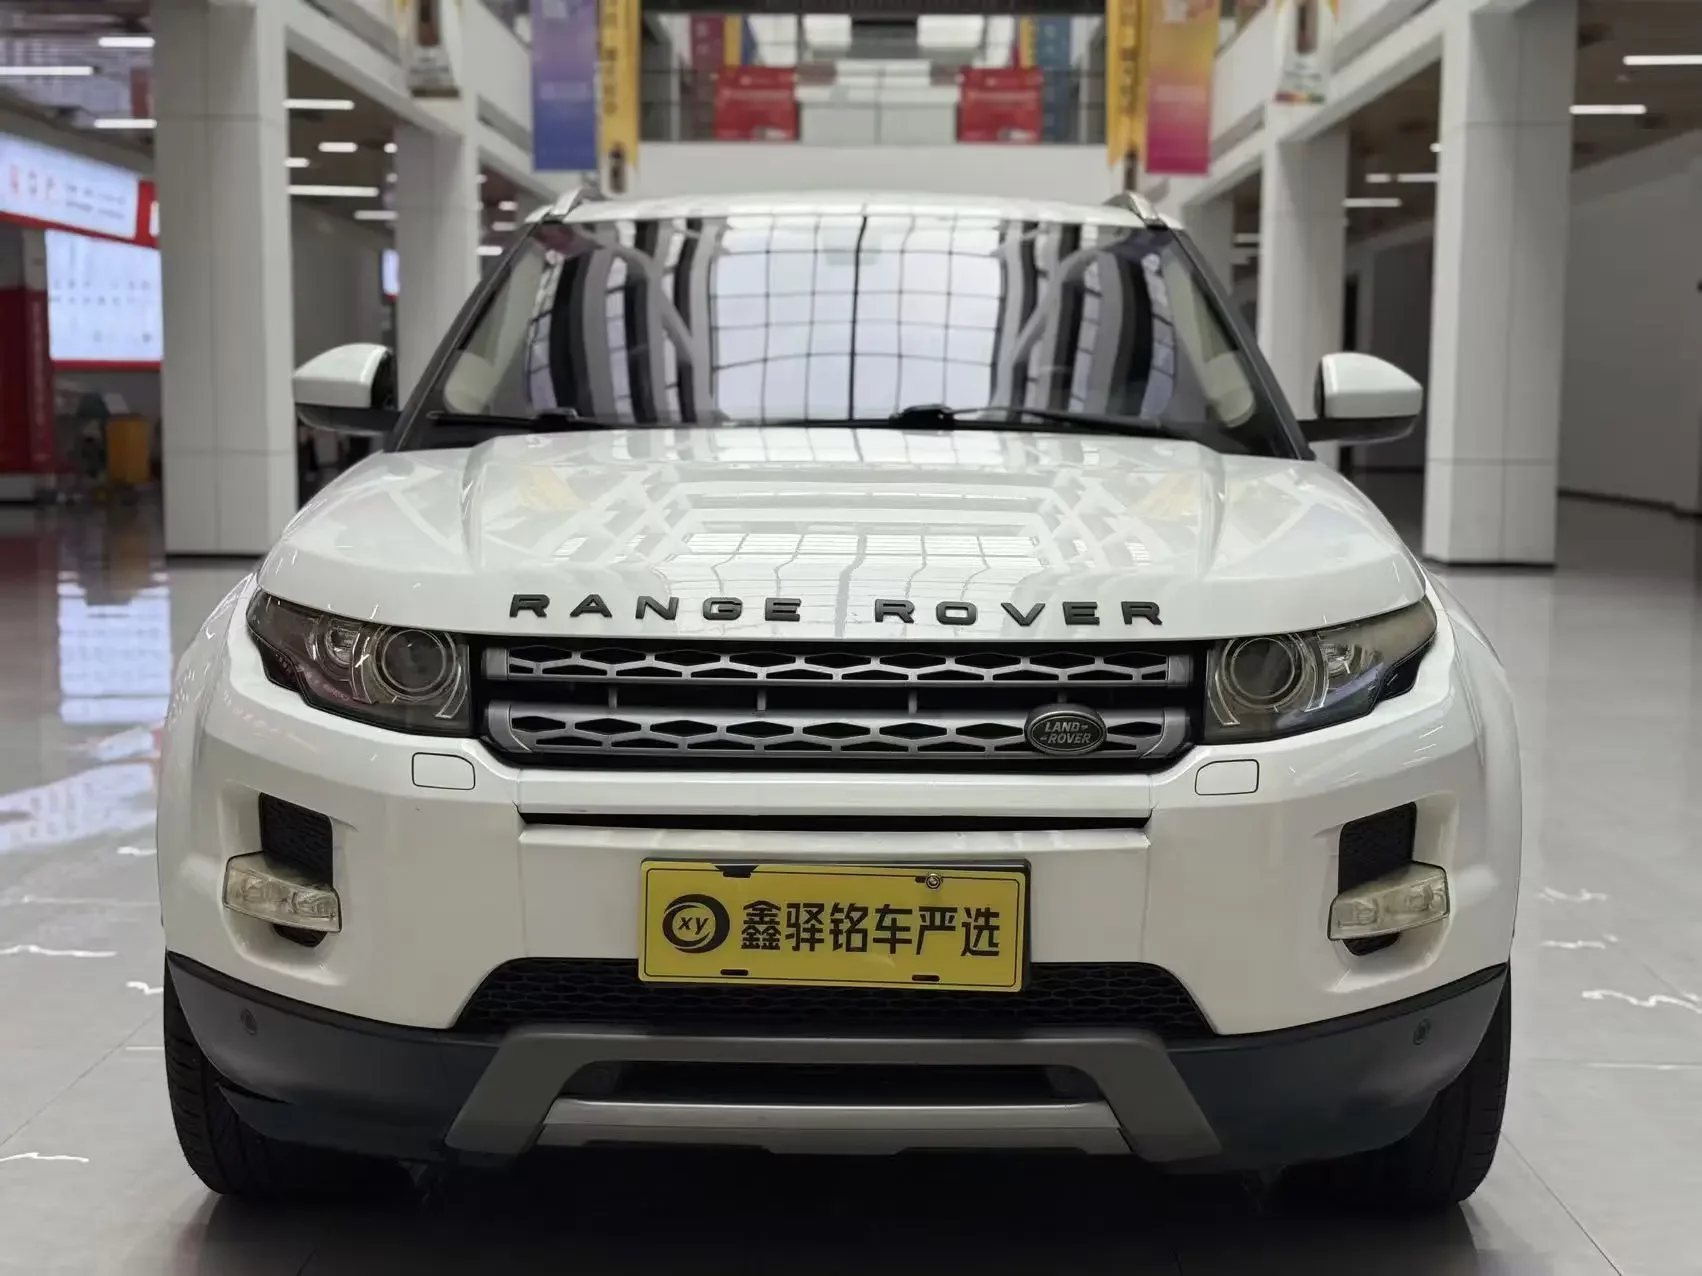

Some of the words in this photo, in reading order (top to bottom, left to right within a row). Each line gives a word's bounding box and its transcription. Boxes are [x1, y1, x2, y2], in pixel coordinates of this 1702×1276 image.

[509, 593, 802, 622] RANGE
[874, 598, 1164, 627] ROVER
[1044, 721, 1080, 733] LAND
[1047, 732, 1092, 744] ROVER
[740, 899, 1001, 957] 鑫驿铭车严选
